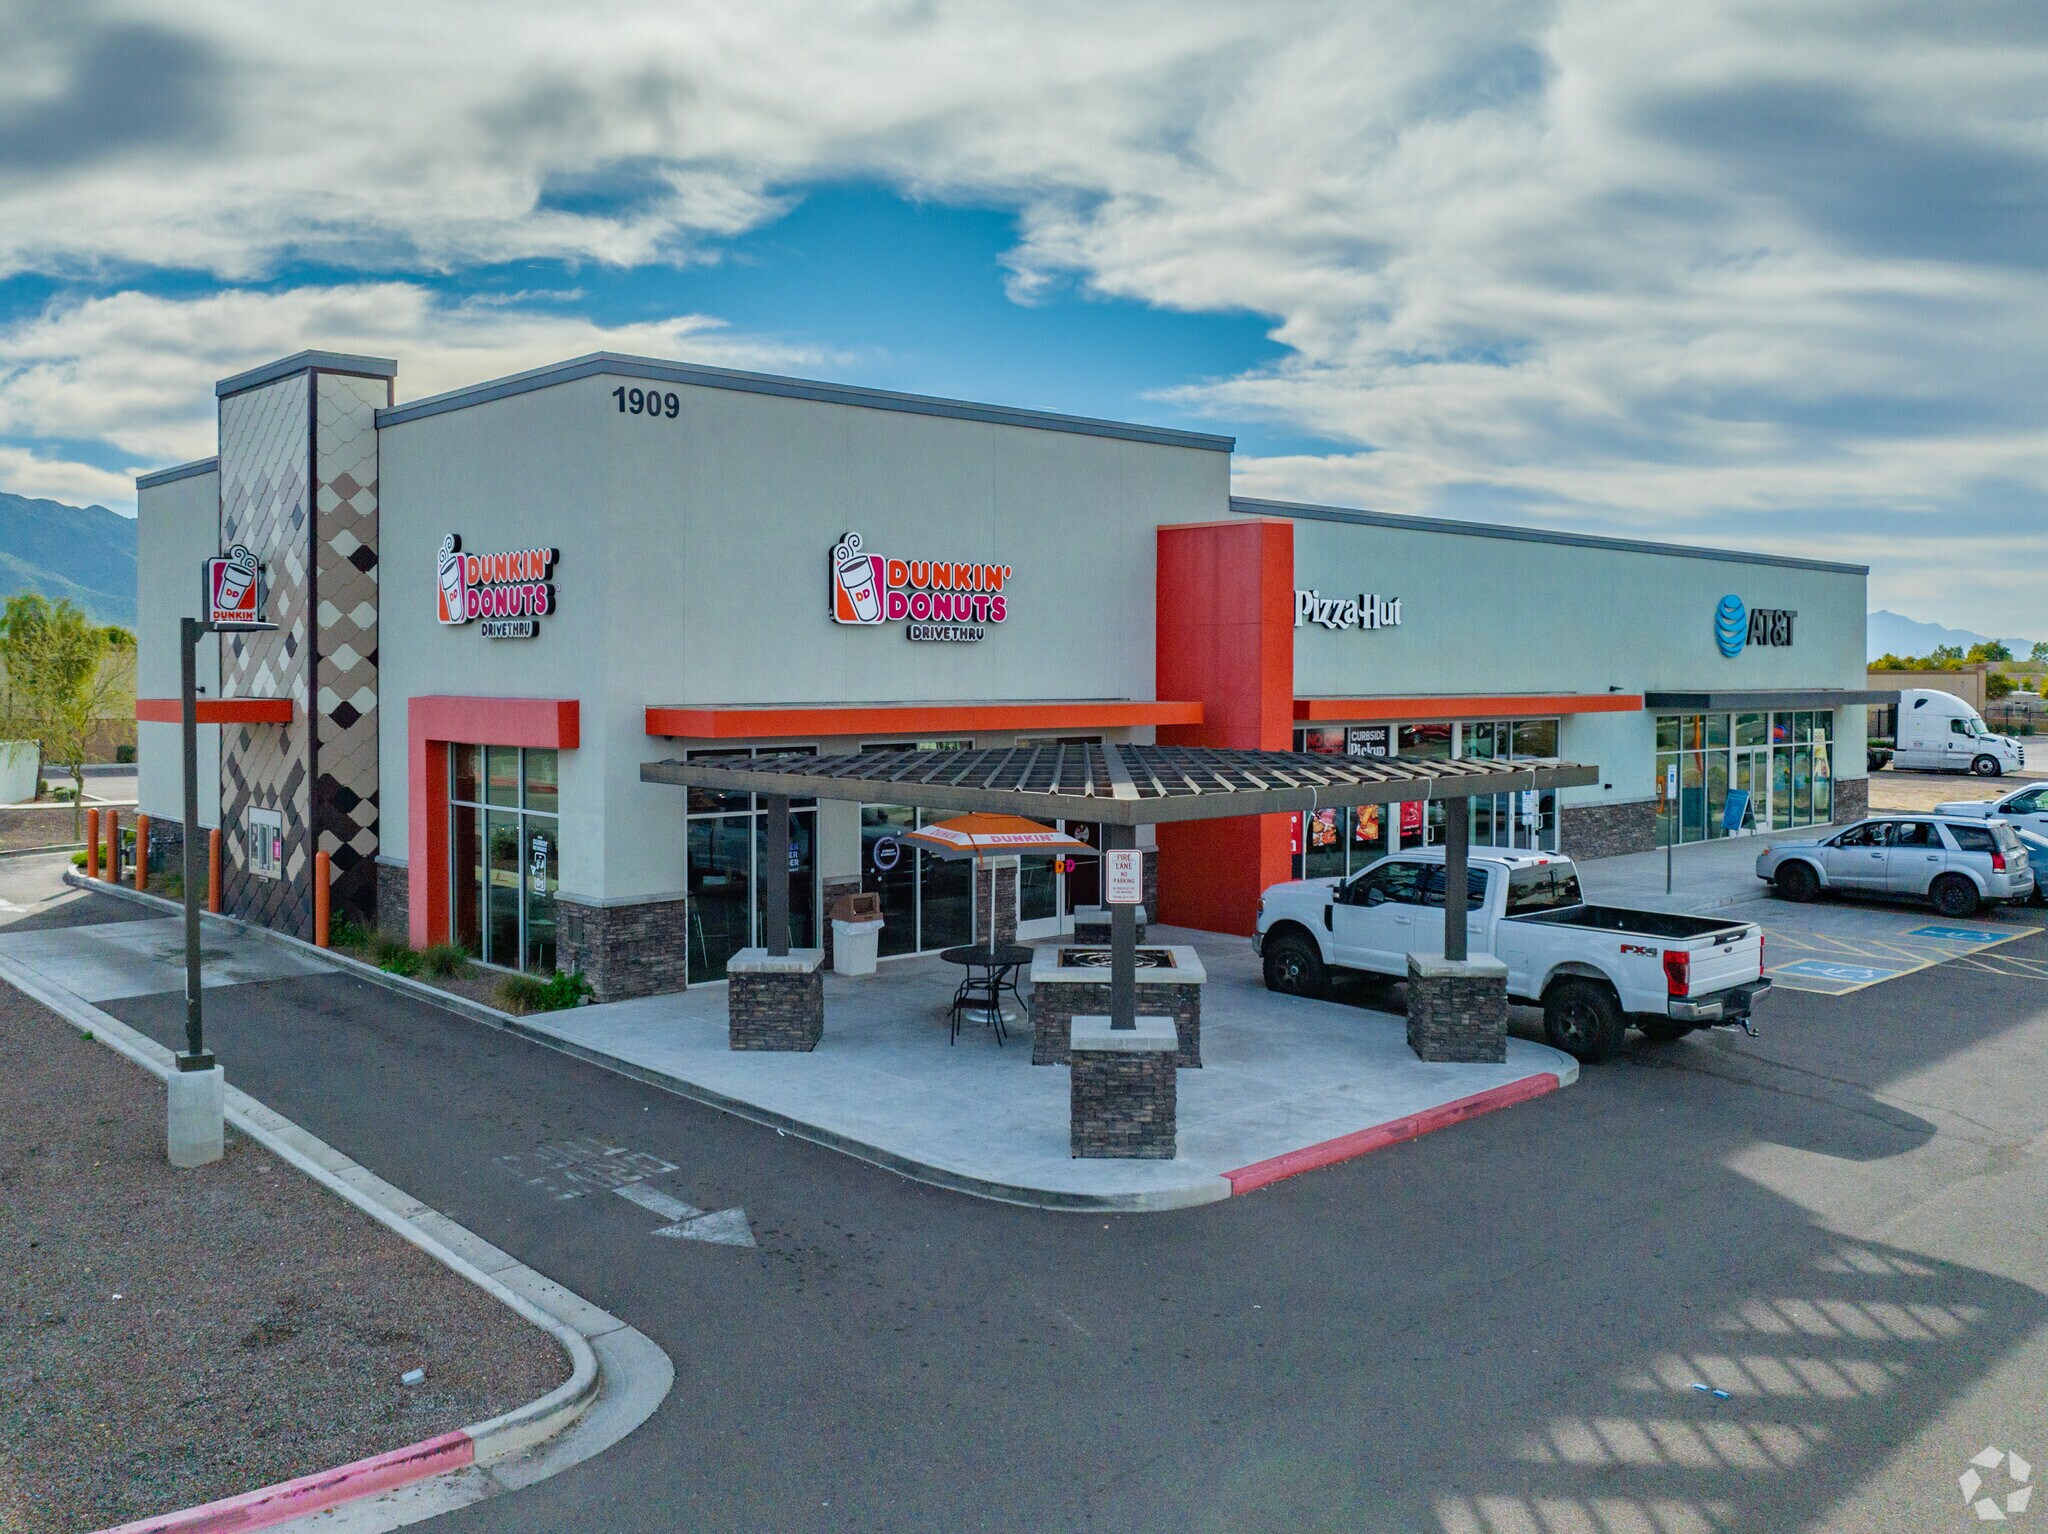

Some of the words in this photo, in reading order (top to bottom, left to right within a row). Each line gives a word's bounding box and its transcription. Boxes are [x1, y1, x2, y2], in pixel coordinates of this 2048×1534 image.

[612, 386, 680, 419] 1909
[467, 548, 551, 586] DUNKIN'
[887, 559, 1011, 592] DUNKIN'
[467, 584, 547, 618] DONUTS
[887, 591, 1007, 622] DONUTS
[1294, 589, 1359, 629] Pizza
[1359, 594, 1402, 629] Hut
[1746, 608, 1798, 647] AT&T
[1350, 742, 1386, 756] Pickup
[1351, 730, 1385, 742] CURBSIDE
[990, 834, 1054, 843] DUNKIN'
[1115, 862, 1133, 870] LANE
[1620, 943, 1658, 958] FX4
